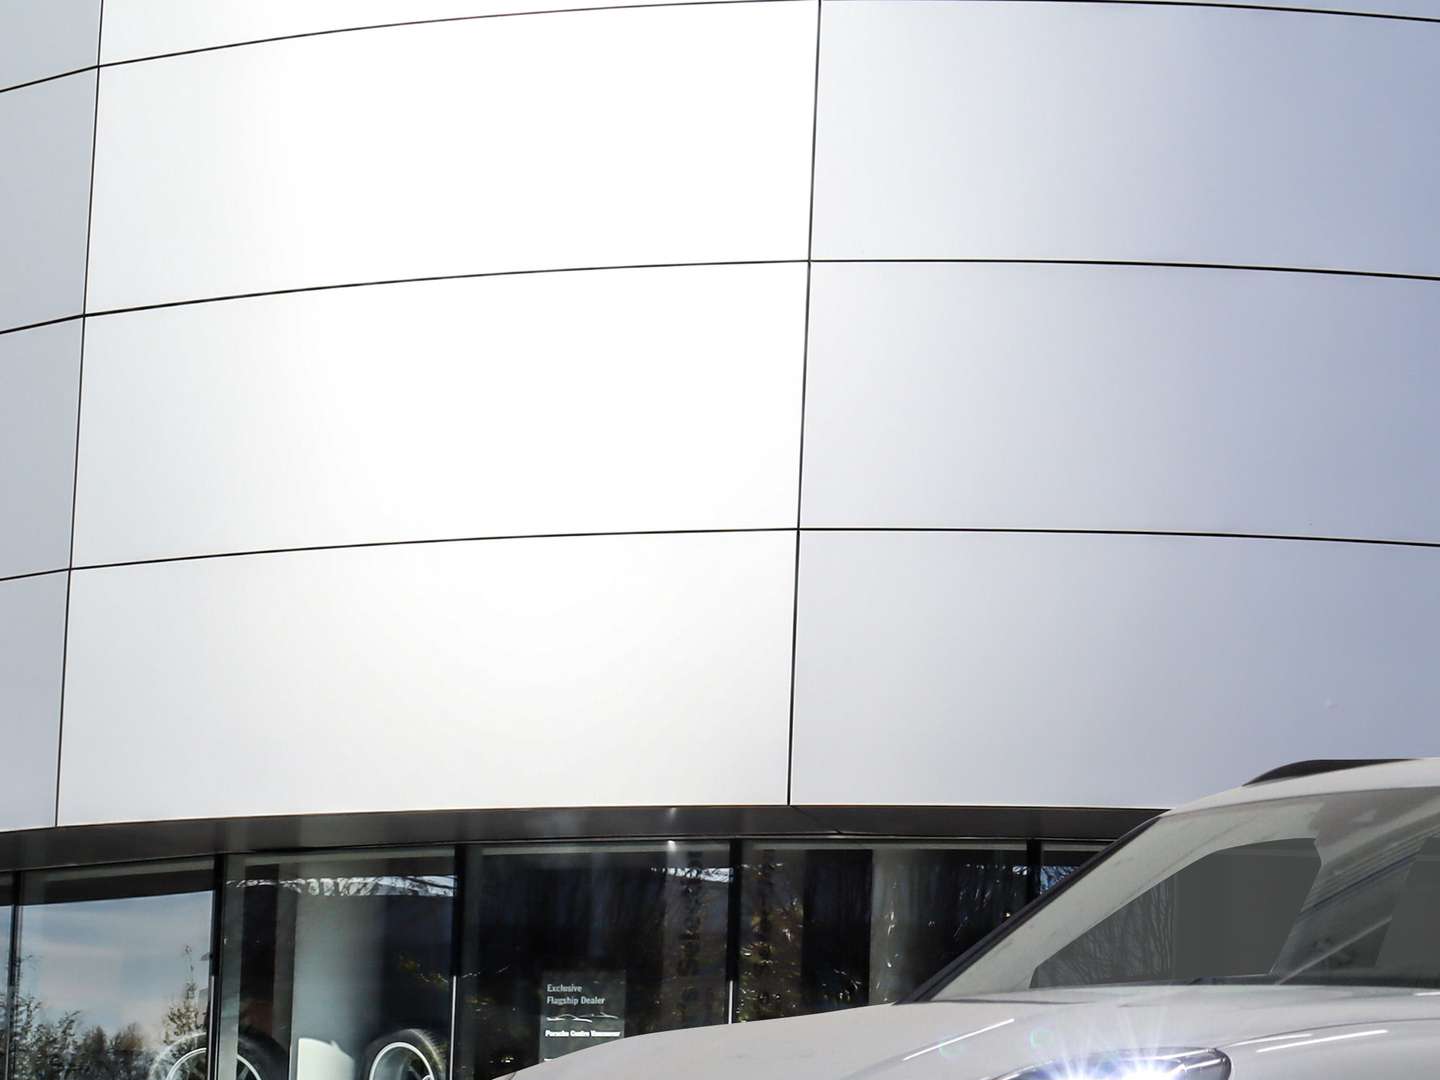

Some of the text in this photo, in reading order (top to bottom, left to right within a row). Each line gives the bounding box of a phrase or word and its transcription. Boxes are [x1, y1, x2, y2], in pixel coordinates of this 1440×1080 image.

[546, 983, 583, 993] Exclusive
[546, 995, 606, 1006] Flagship Dealer
